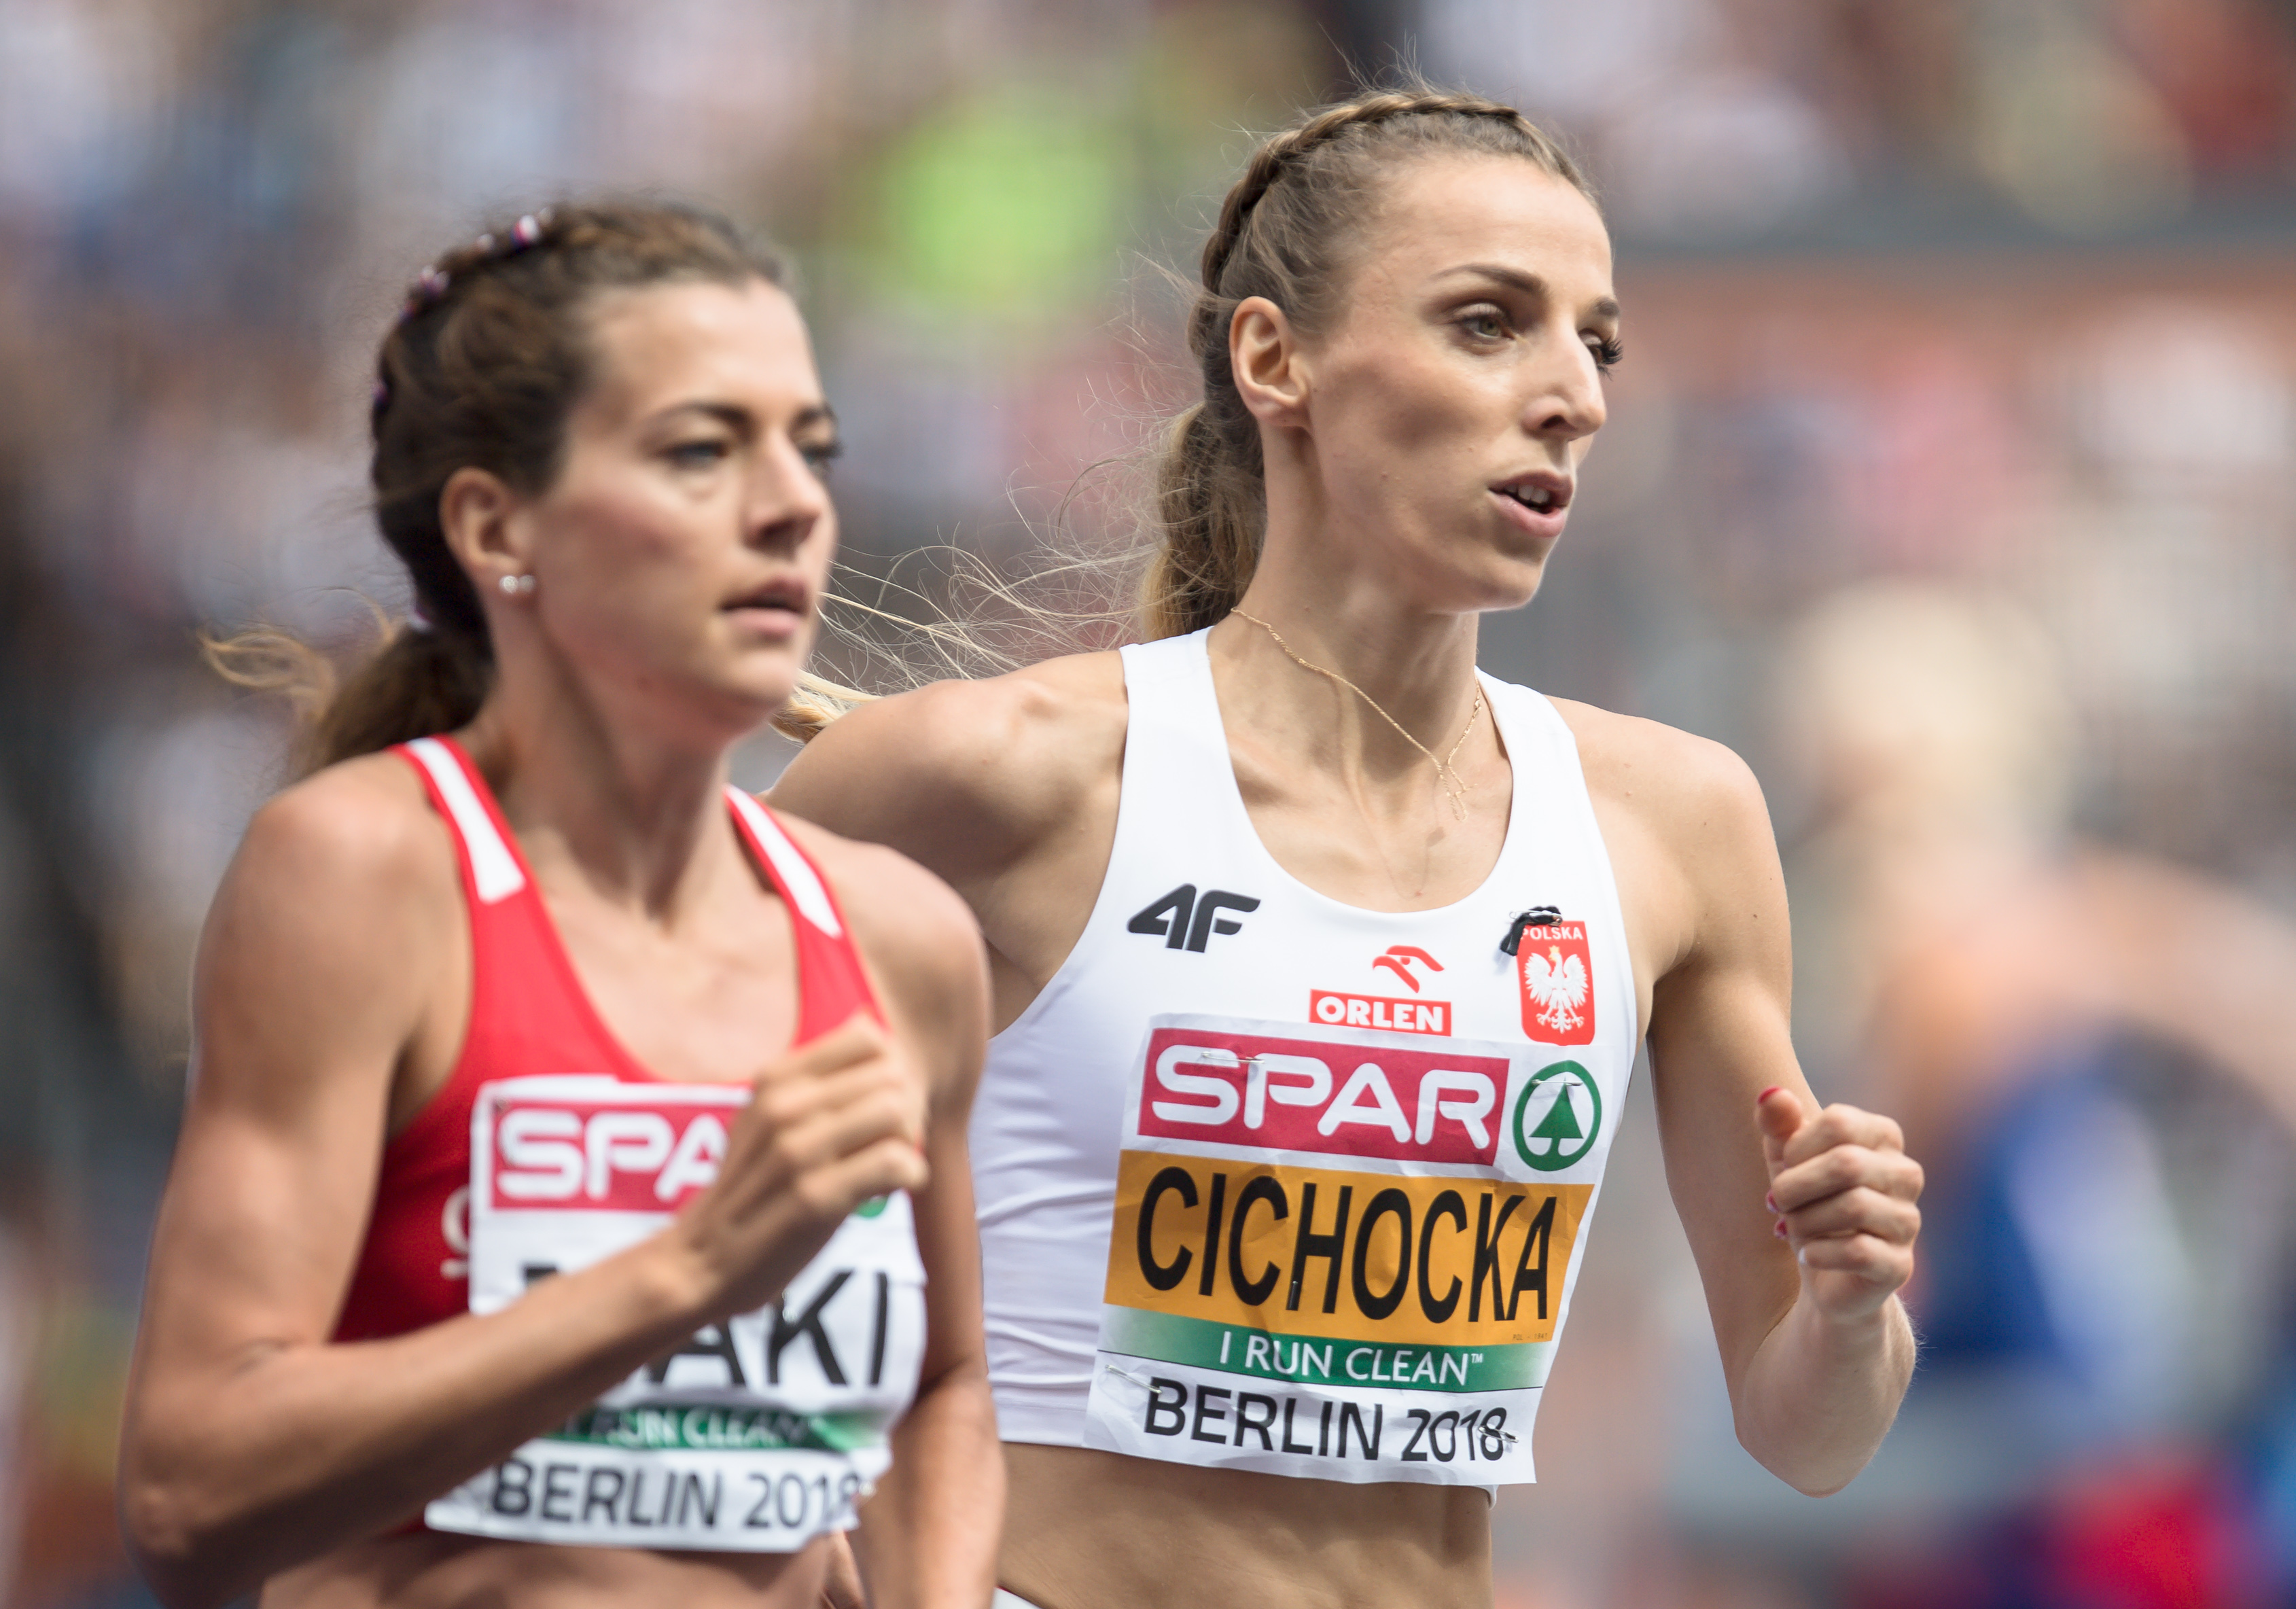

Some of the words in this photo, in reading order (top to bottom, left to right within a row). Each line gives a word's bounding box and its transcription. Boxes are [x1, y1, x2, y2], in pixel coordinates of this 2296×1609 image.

[1127, 883, 1261, 953] 4F
[1316, 996, 1443, 1032] ORLEN
[1152, 1044, 1497, 1150] SPAR
[497, 1109, 729, 1202] SPA
[1136, 1166, 1558, 1324] CICHOCKA
[1220, 1330, 1231, 1364] I
[1245, 1335, 1332, 1378] RUN
[1144, 1376, 1383, 1462] BERLIN
[1400, 1407, 1508, 1463] 2018
[491, 1458, 722, 1530] BERLIN
